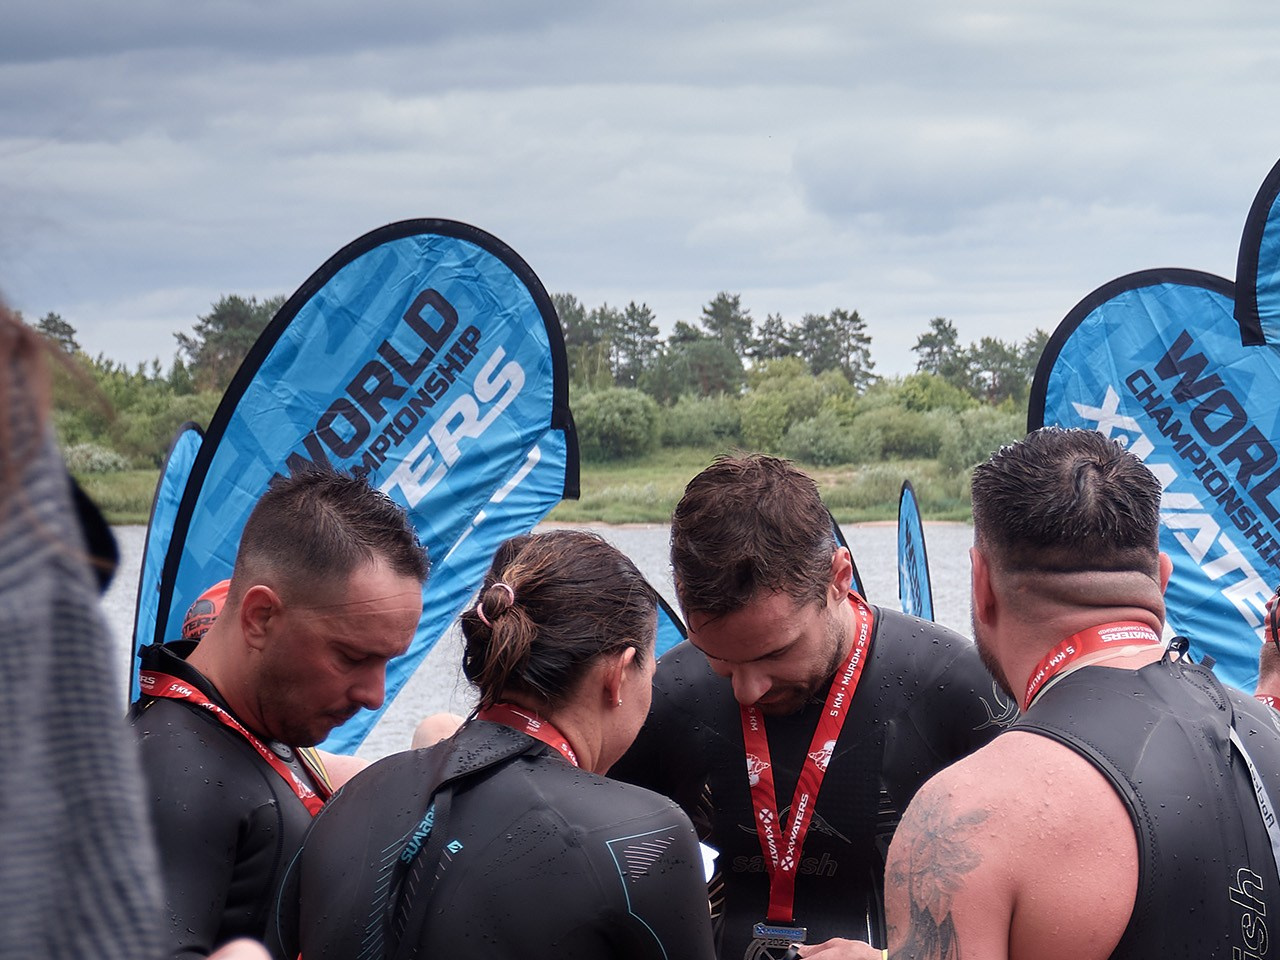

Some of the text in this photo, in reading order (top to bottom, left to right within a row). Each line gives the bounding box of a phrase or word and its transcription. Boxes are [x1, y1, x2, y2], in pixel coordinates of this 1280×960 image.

[268, 288, 459, 485] WORLD
[351, 325, 482, 479] MPIONSHIP
[169, 683, 193, 698] 5 KM
[830, 709, 838, 717] 5
[834, 692, 845, 709] KM
[843, 647, 862, 687] MUROM
[858, 623, 869, 647] 2025
[1026, 645, 1075, 699] 5 KM MUR
[731, 852, 838, 877] sash
